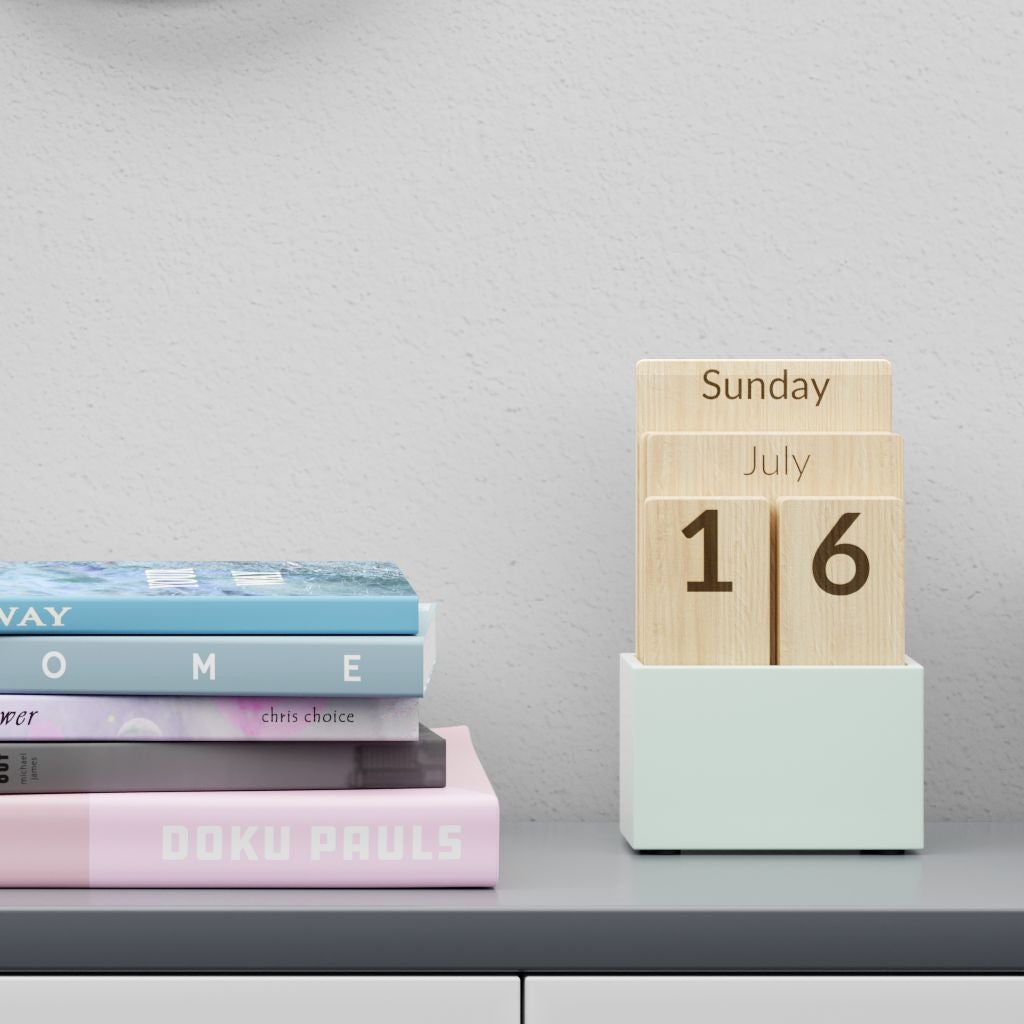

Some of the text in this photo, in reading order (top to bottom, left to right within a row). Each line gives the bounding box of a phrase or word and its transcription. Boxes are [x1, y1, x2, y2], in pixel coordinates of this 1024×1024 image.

[702, 369, 830, 407] Sunday
[743, 445, 811, 482] July
[261, 706, 356, 724] chris choice
[19, 753, 28, 785] michael
[30, 756, 39, 781] james
[161, 824, 463, 861] DOKU PAULS
